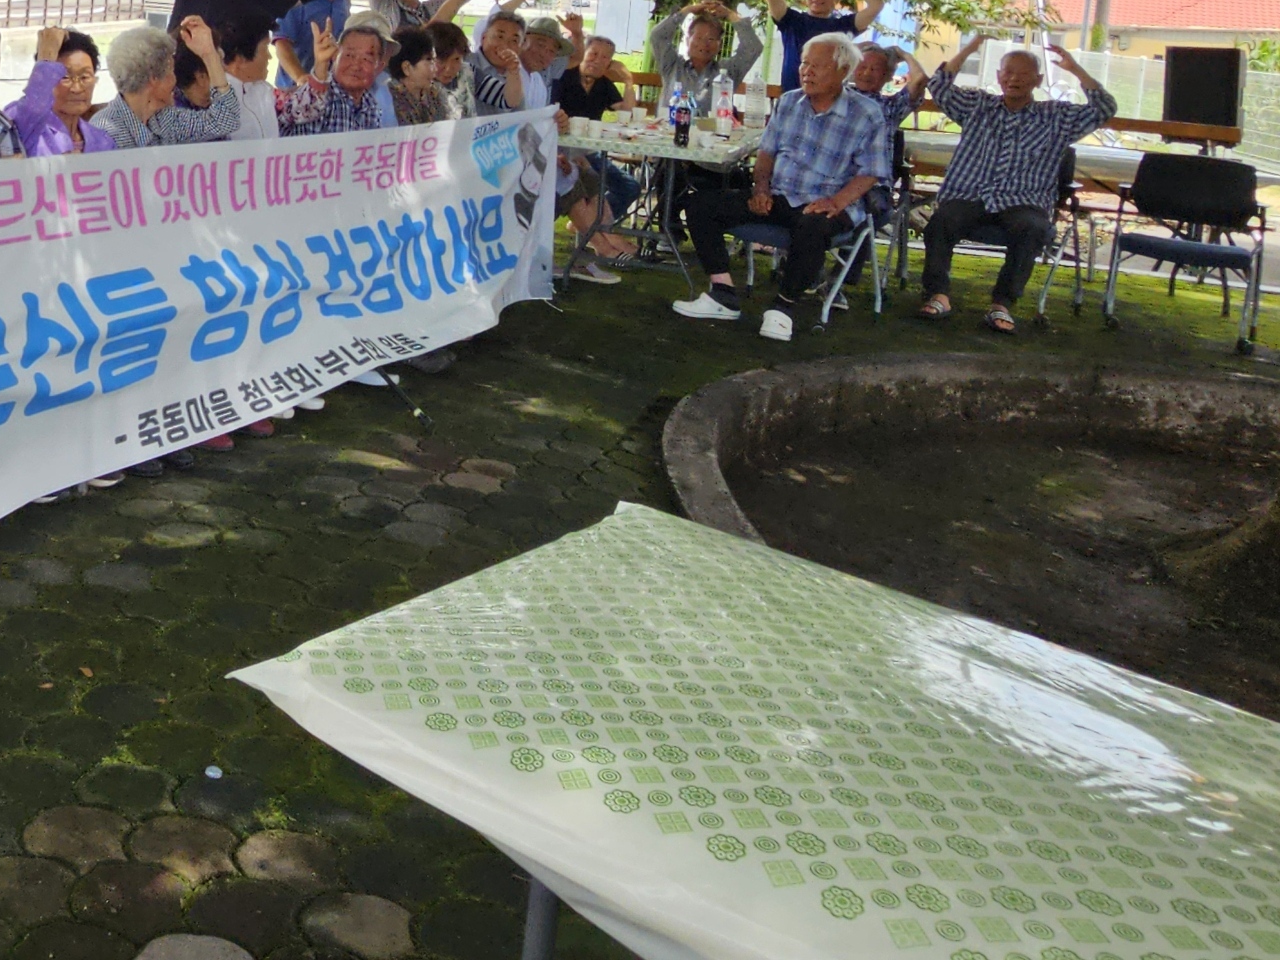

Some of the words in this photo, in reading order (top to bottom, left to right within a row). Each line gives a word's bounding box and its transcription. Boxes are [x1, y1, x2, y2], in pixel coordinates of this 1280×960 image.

[153, 162, 222, 223] 있어
[228, 157, 257, 212] 더
[265, 148, 344, 206] 따뜻한
[351, 136, 441, 192] 죽동마을
[179, 240, 311, 362] 항상
[305, 194, 519, 319] 건강하세요
[137, 388, 242, 448] 죽동마을
[378, 333, 427, 355] 일동
